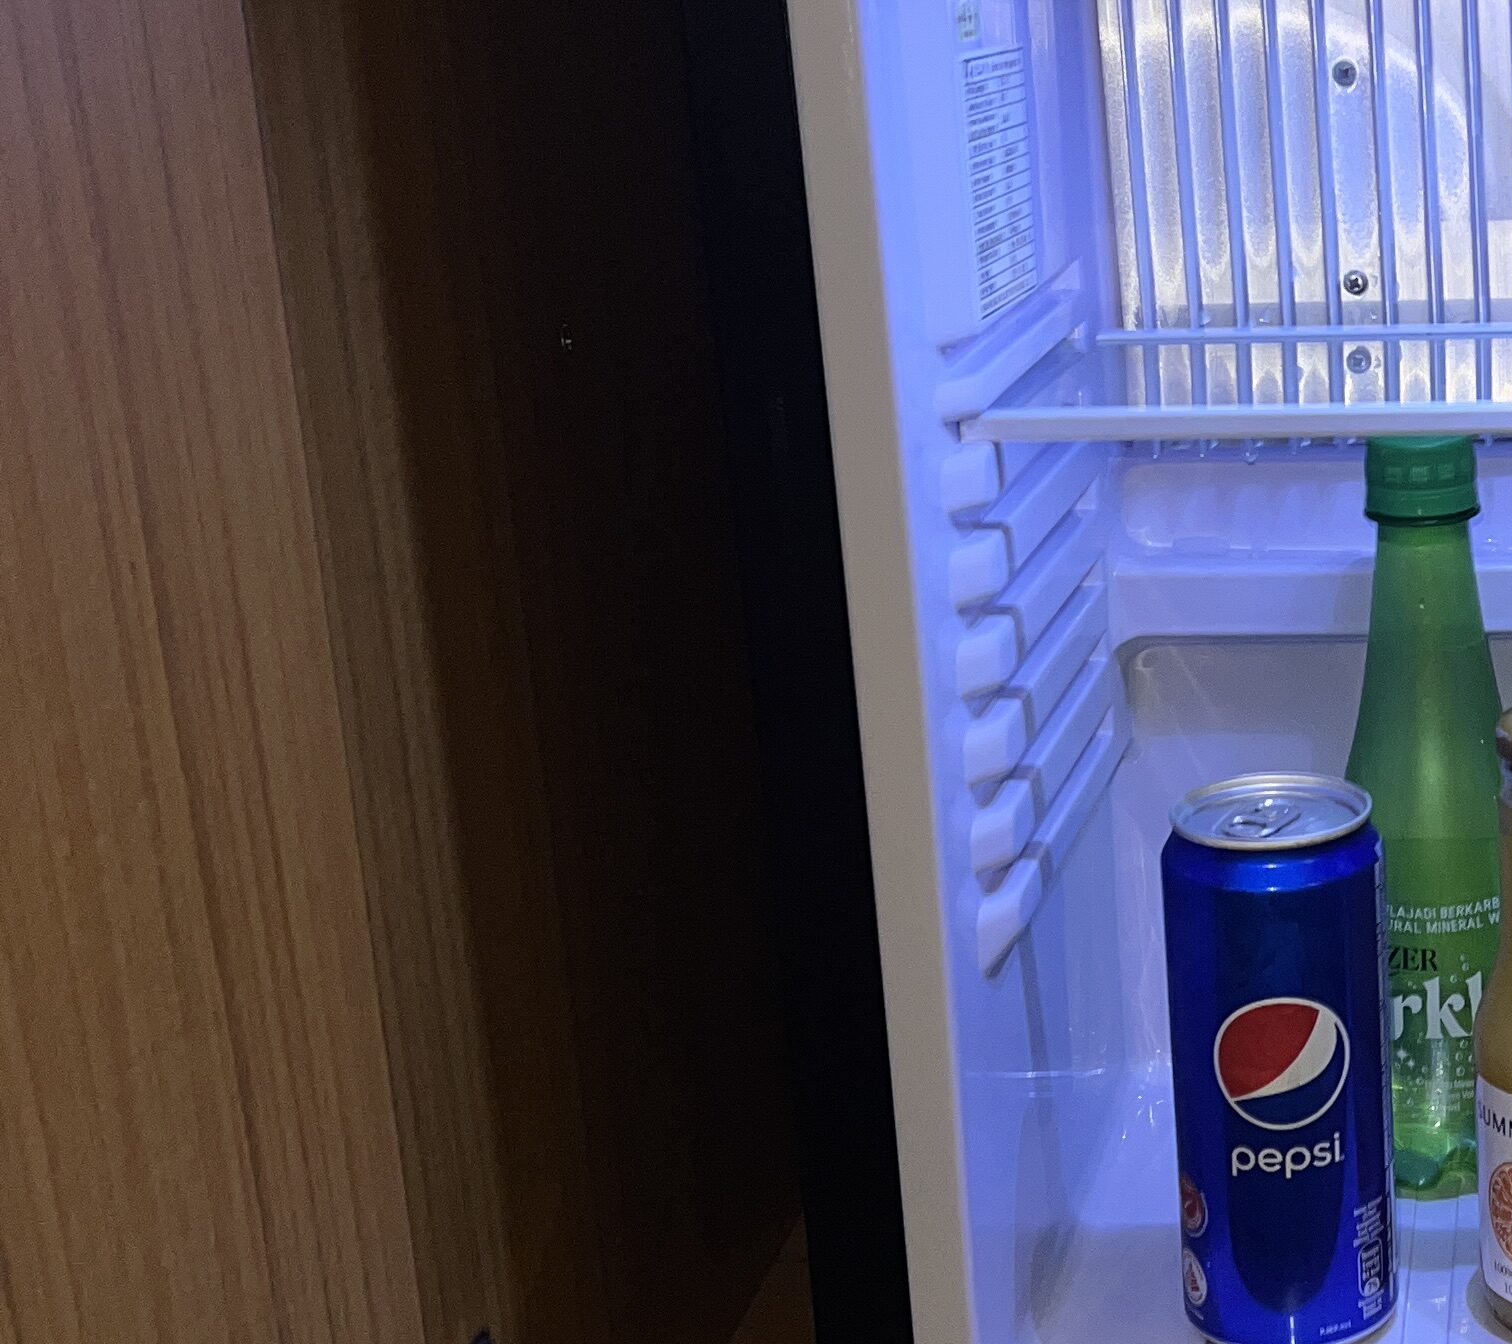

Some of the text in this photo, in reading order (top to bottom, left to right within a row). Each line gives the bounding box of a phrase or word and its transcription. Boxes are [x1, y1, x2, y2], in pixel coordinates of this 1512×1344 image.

[1386, 903, 1437, 920] LAJADI
[1426, 914, 1484, 935] MINERAL
[1232, 1132, 1340, 1179] pepsi
